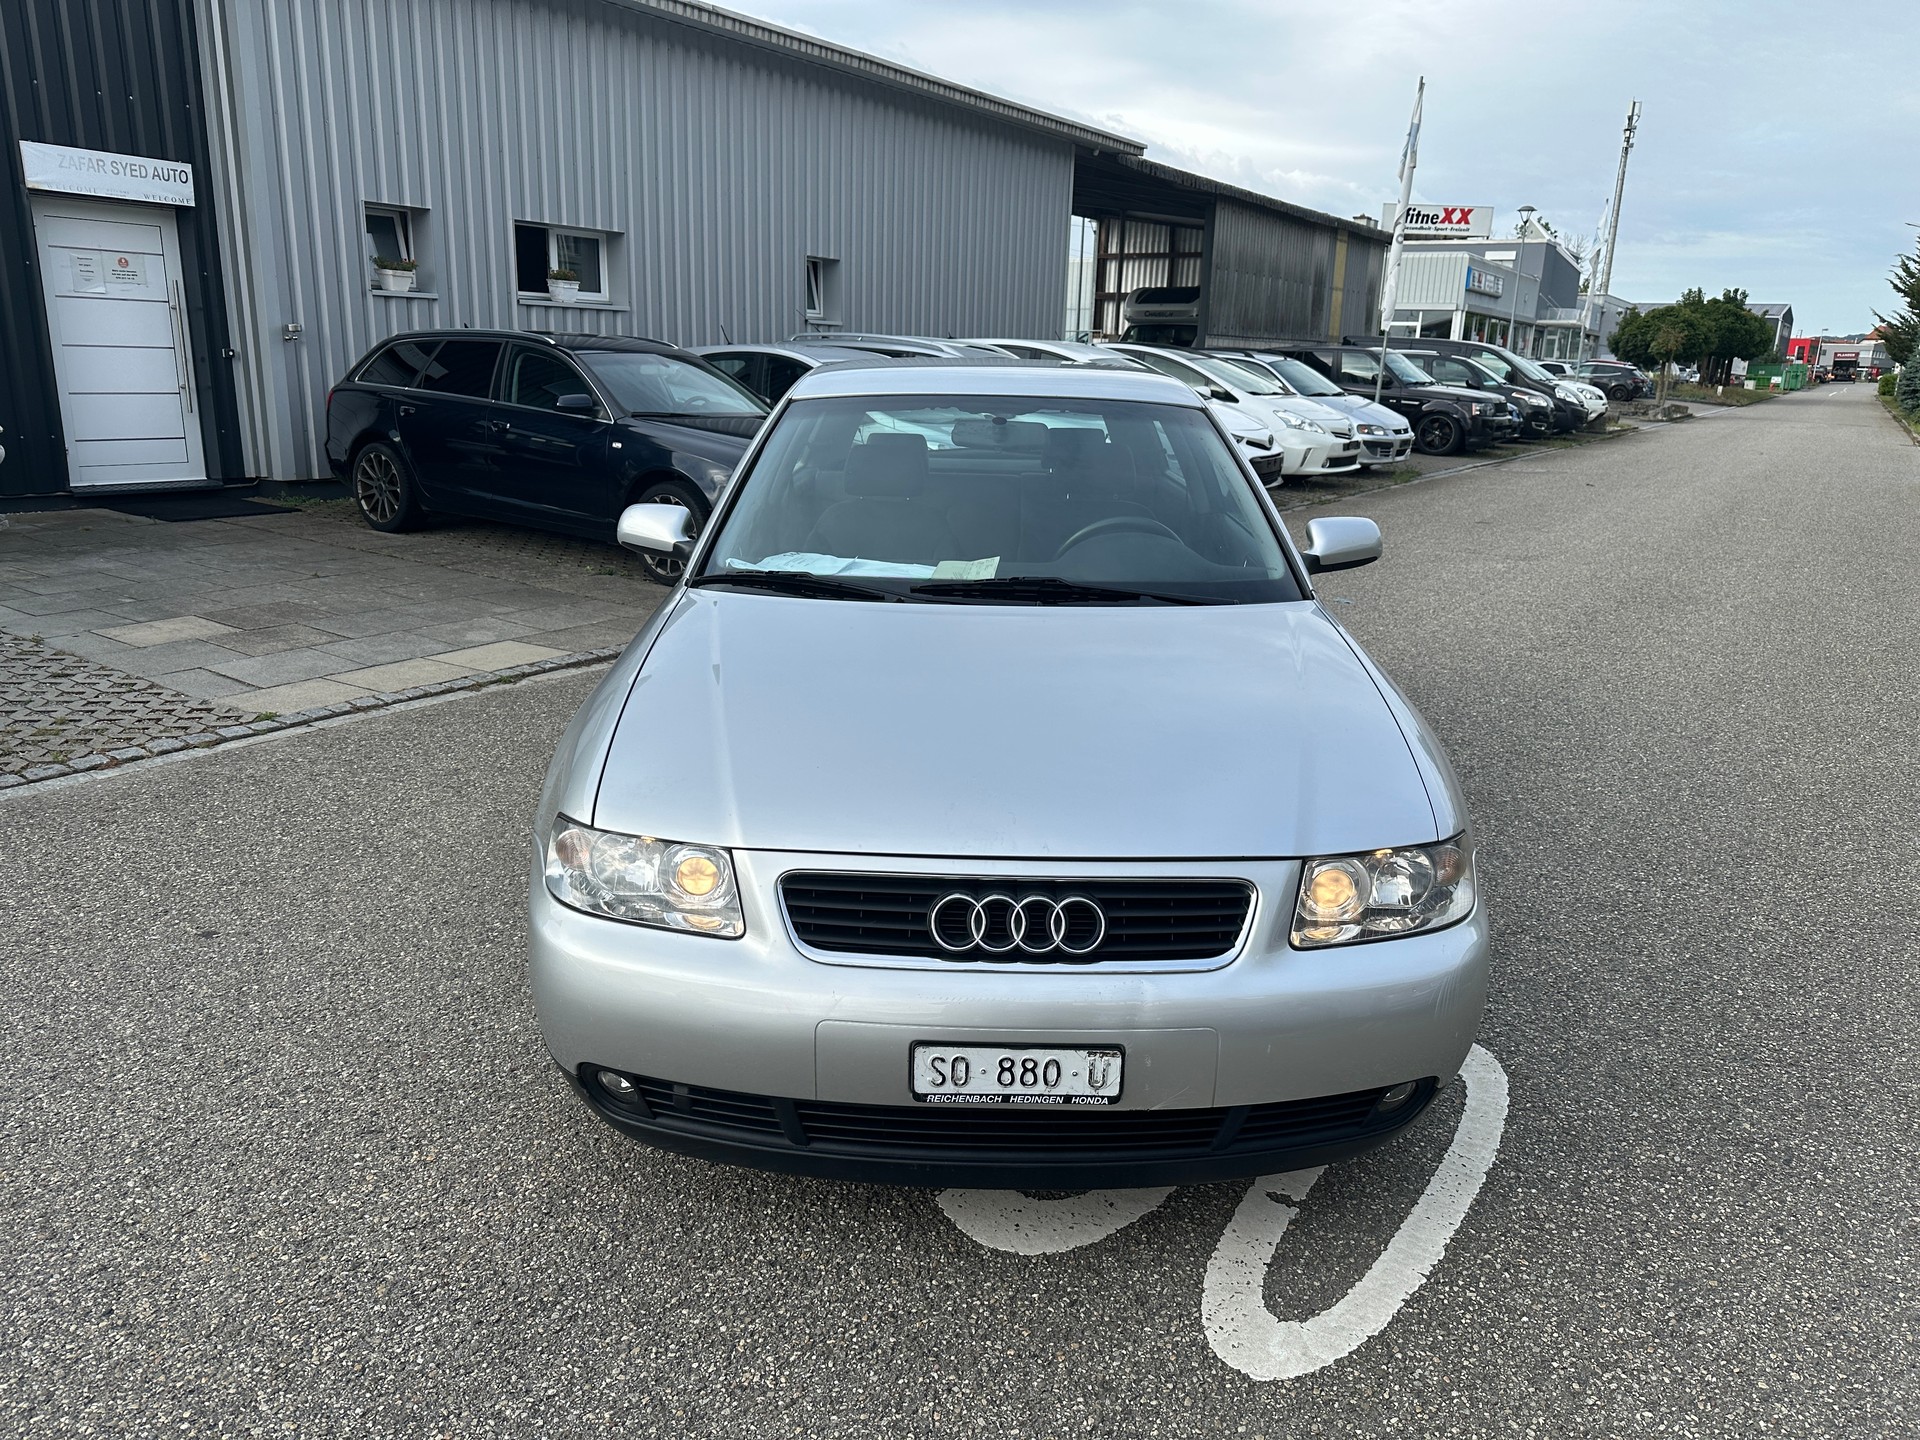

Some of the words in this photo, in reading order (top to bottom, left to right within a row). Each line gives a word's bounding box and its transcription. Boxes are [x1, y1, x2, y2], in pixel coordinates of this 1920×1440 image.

[58, 154, 107, 174] ZAFAR
[111, 161, 148, 179] SYED
[152, 166, 189, 184] AUTO
[143, 193, 191, 205] WELCOME
[997, 1055, 1062, 1088] 880
[1087, 1056, 1110, 1089] U
[926, 1094, 1002, 1104] REICHENBACH
[1009, 1096, 1064, 1104] HEDINGEN
[1071, 1097, 1109, 1105] HONDA
